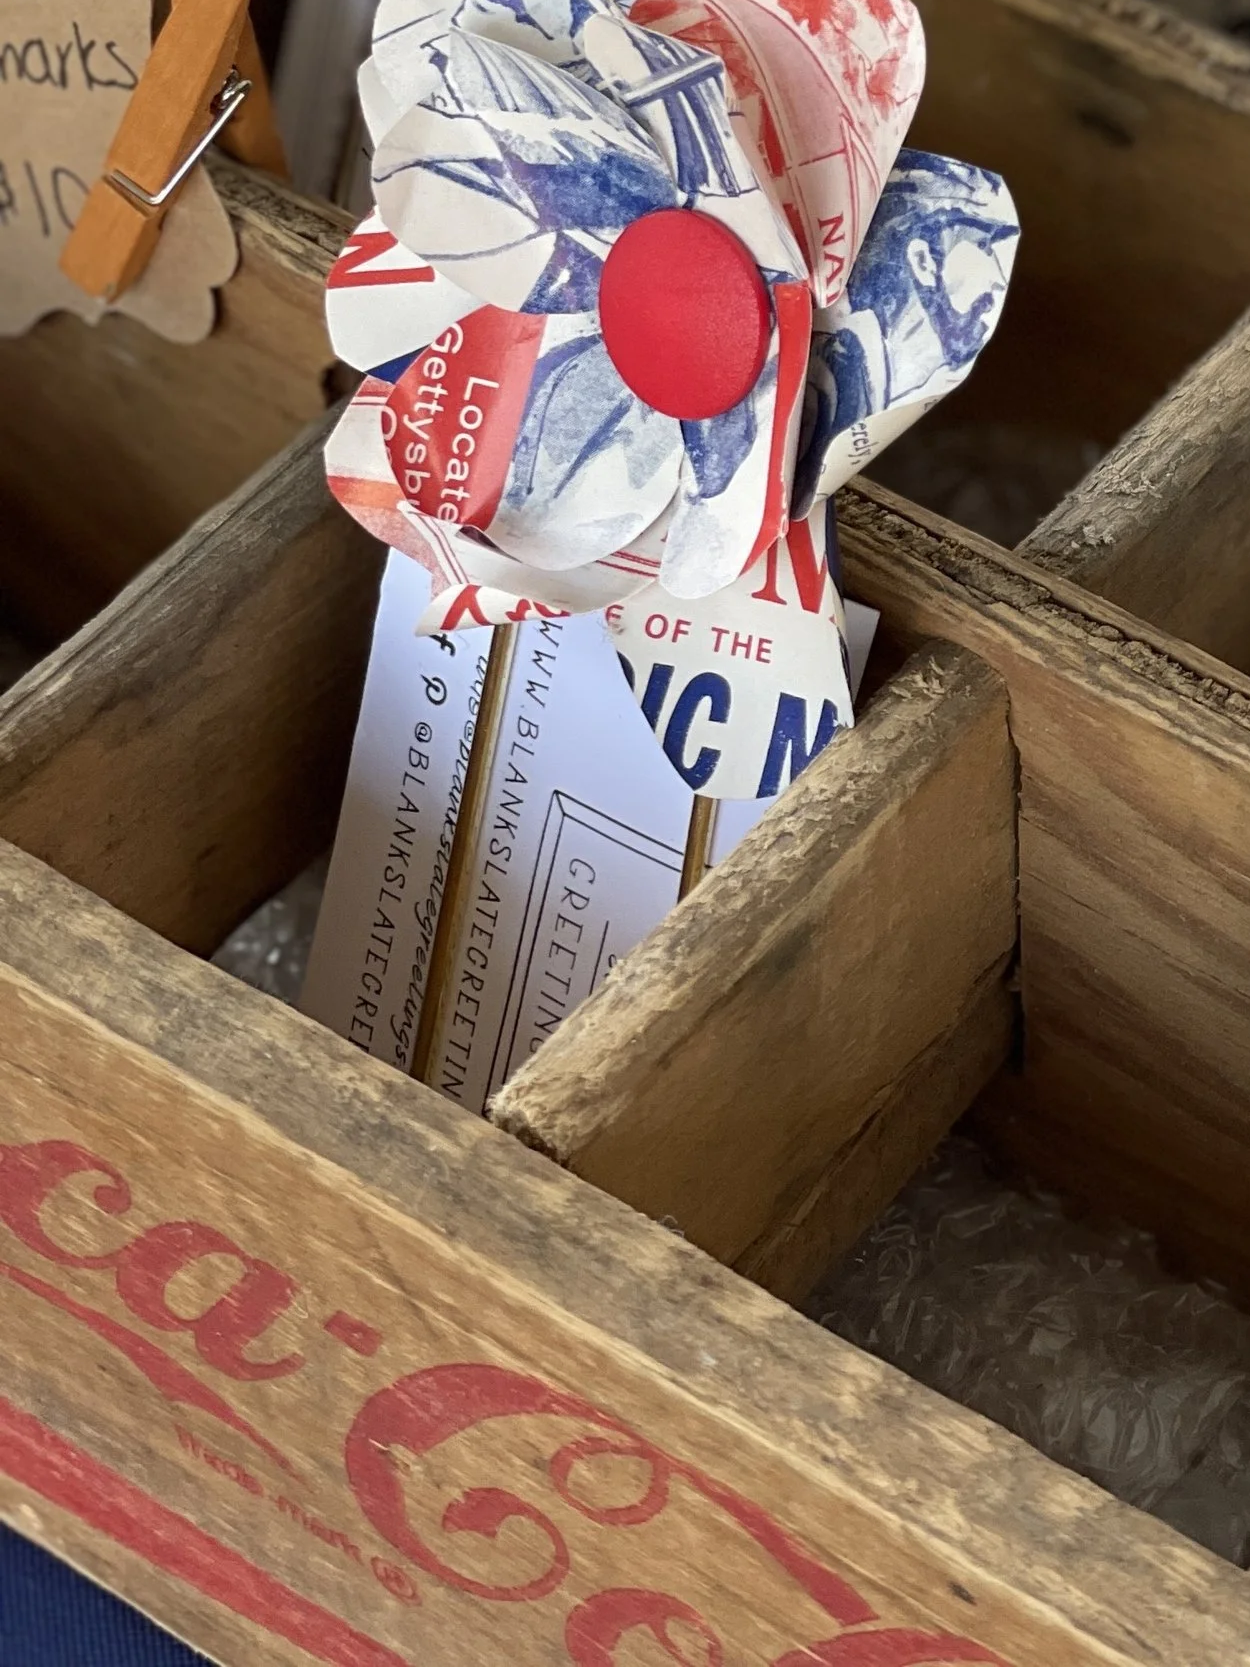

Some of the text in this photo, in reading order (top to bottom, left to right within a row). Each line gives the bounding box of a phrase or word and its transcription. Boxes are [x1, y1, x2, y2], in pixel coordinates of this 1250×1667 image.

[436, 375, 500, 525] Locate
[643, 613, 693, 644] OF
[711, 626, 775, 665] THE
